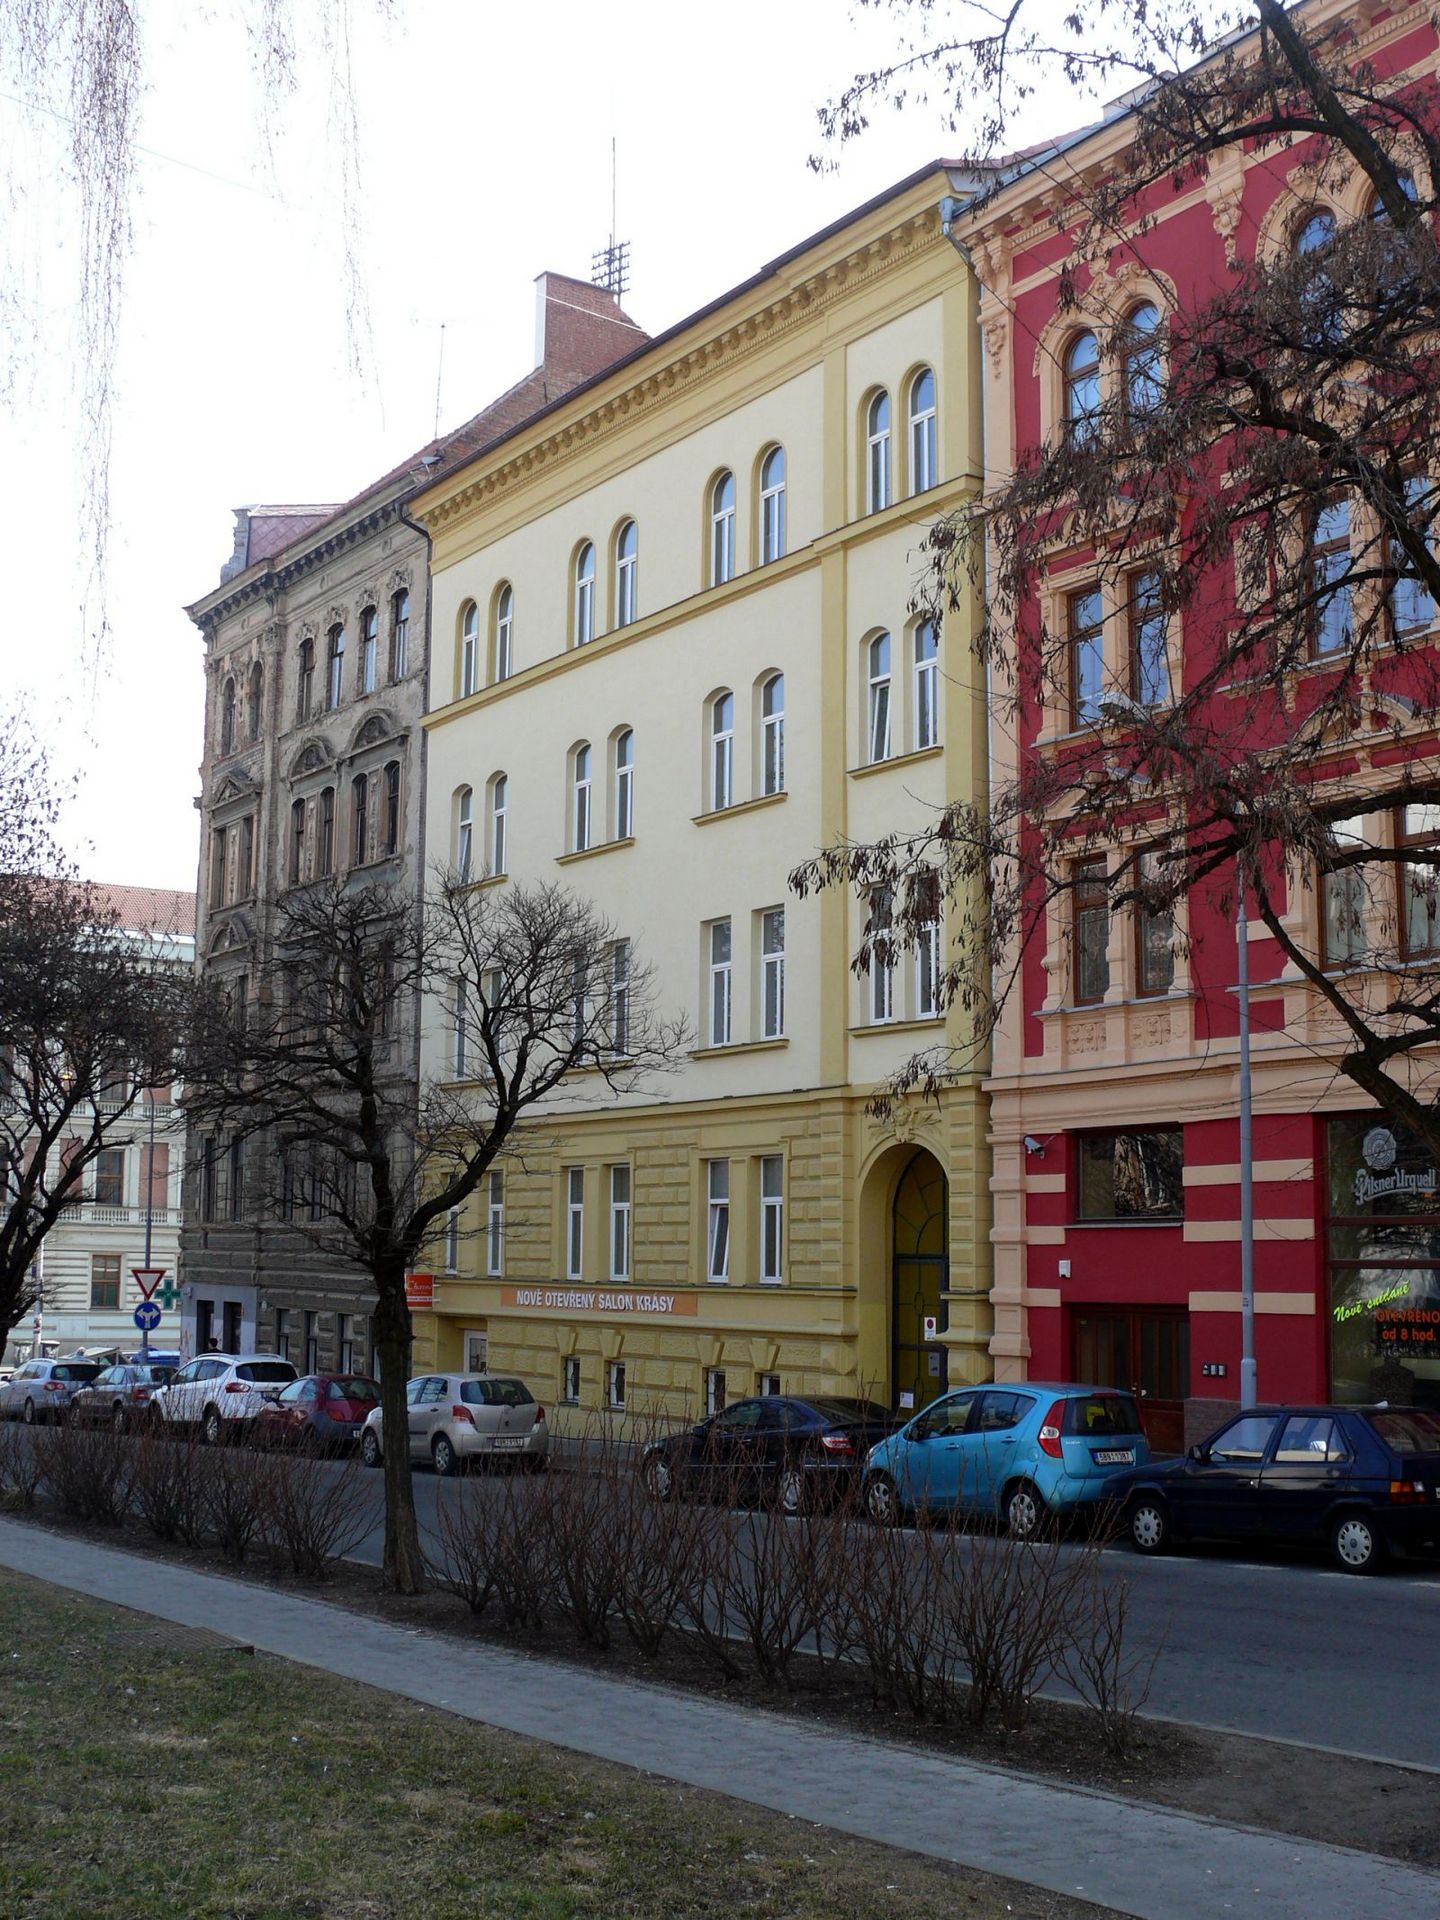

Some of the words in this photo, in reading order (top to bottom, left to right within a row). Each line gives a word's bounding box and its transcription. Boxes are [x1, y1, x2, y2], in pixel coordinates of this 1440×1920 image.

[1353, 1168, 1396, 1205] Pilsner
[1395, 1167, 1436, 1195] Urquell
[516, 1289, 543, 1306] NOVĚ
[545, 1290, 596, 1310] OTEVŘENÝ
[598, 1294, 634, 1312] SALON
[636, 1293, 675, 1313] KRÁSY
[1382, 1327, 1397, 1340] od
[1400, 1327, 1409, 1340] 8
[1411, 1327, 1437, 1341] hod.
